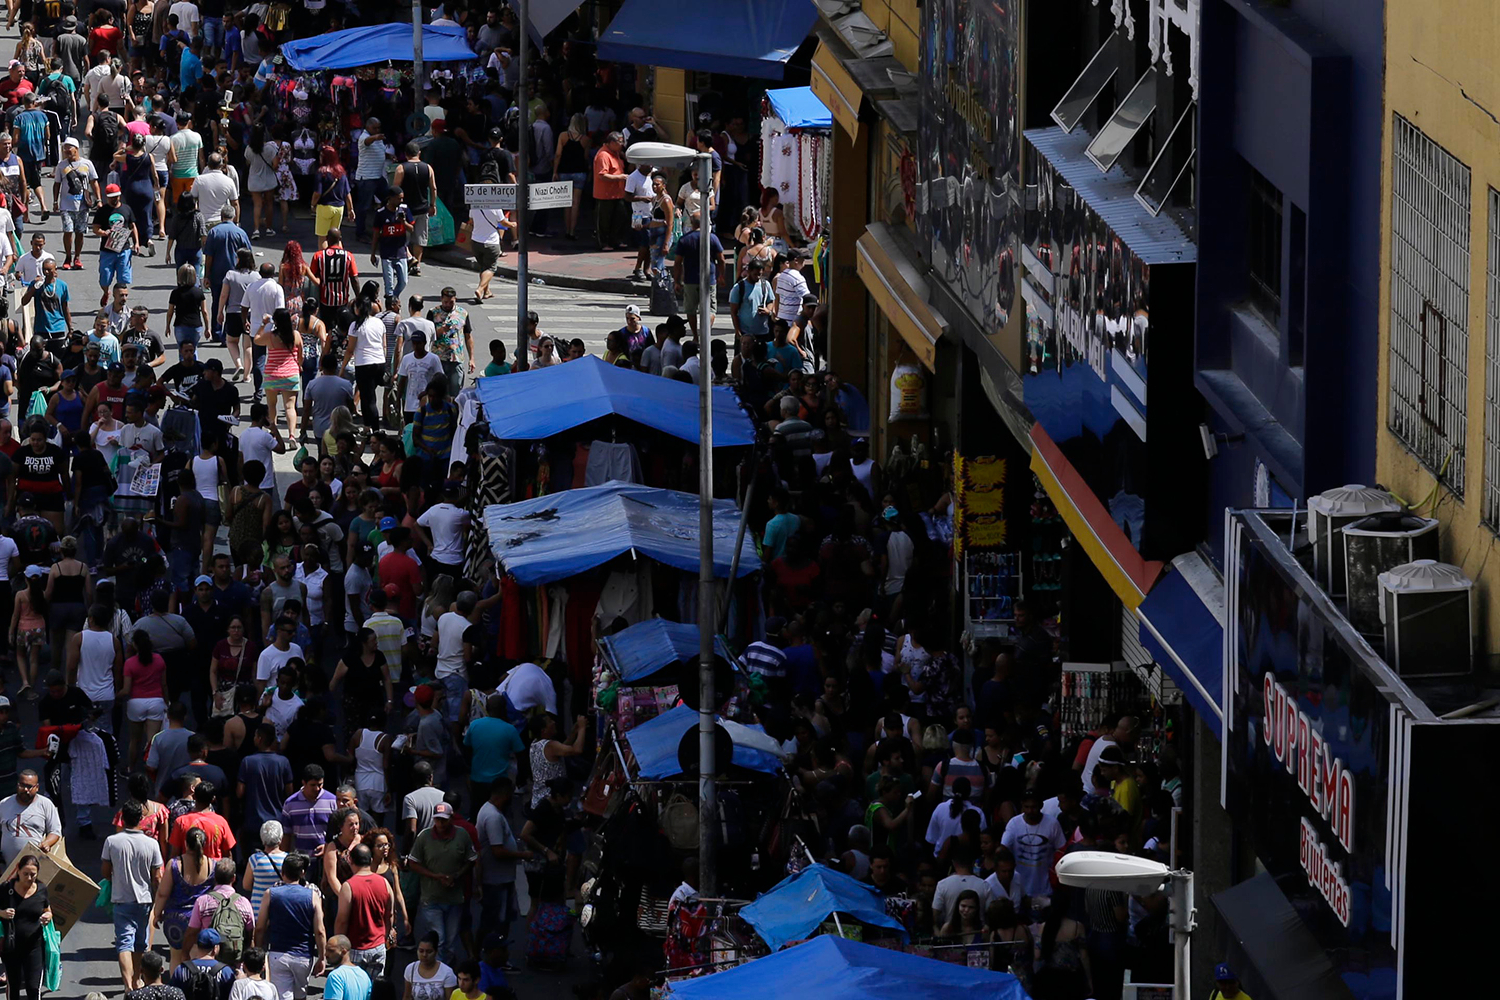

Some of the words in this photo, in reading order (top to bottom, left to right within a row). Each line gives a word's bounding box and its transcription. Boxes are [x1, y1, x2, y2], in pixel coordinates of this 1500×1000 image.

[465, 186, 475, 196] 25
[478, 186, 488, 196] de
[491, 186, 515, 198] Março
[534, 188, 549, 196] Niazi
[549, 185, 569, 195] Chohfi
[183, 374, 199, 384] NIKE
[24, 456, 54, 466] BOSTON
[28, 465, 51, 474] 1986
[1263, 671, 1354, 855] SUPREMA
[1300, 815, 1352, 928] Bijuterias
